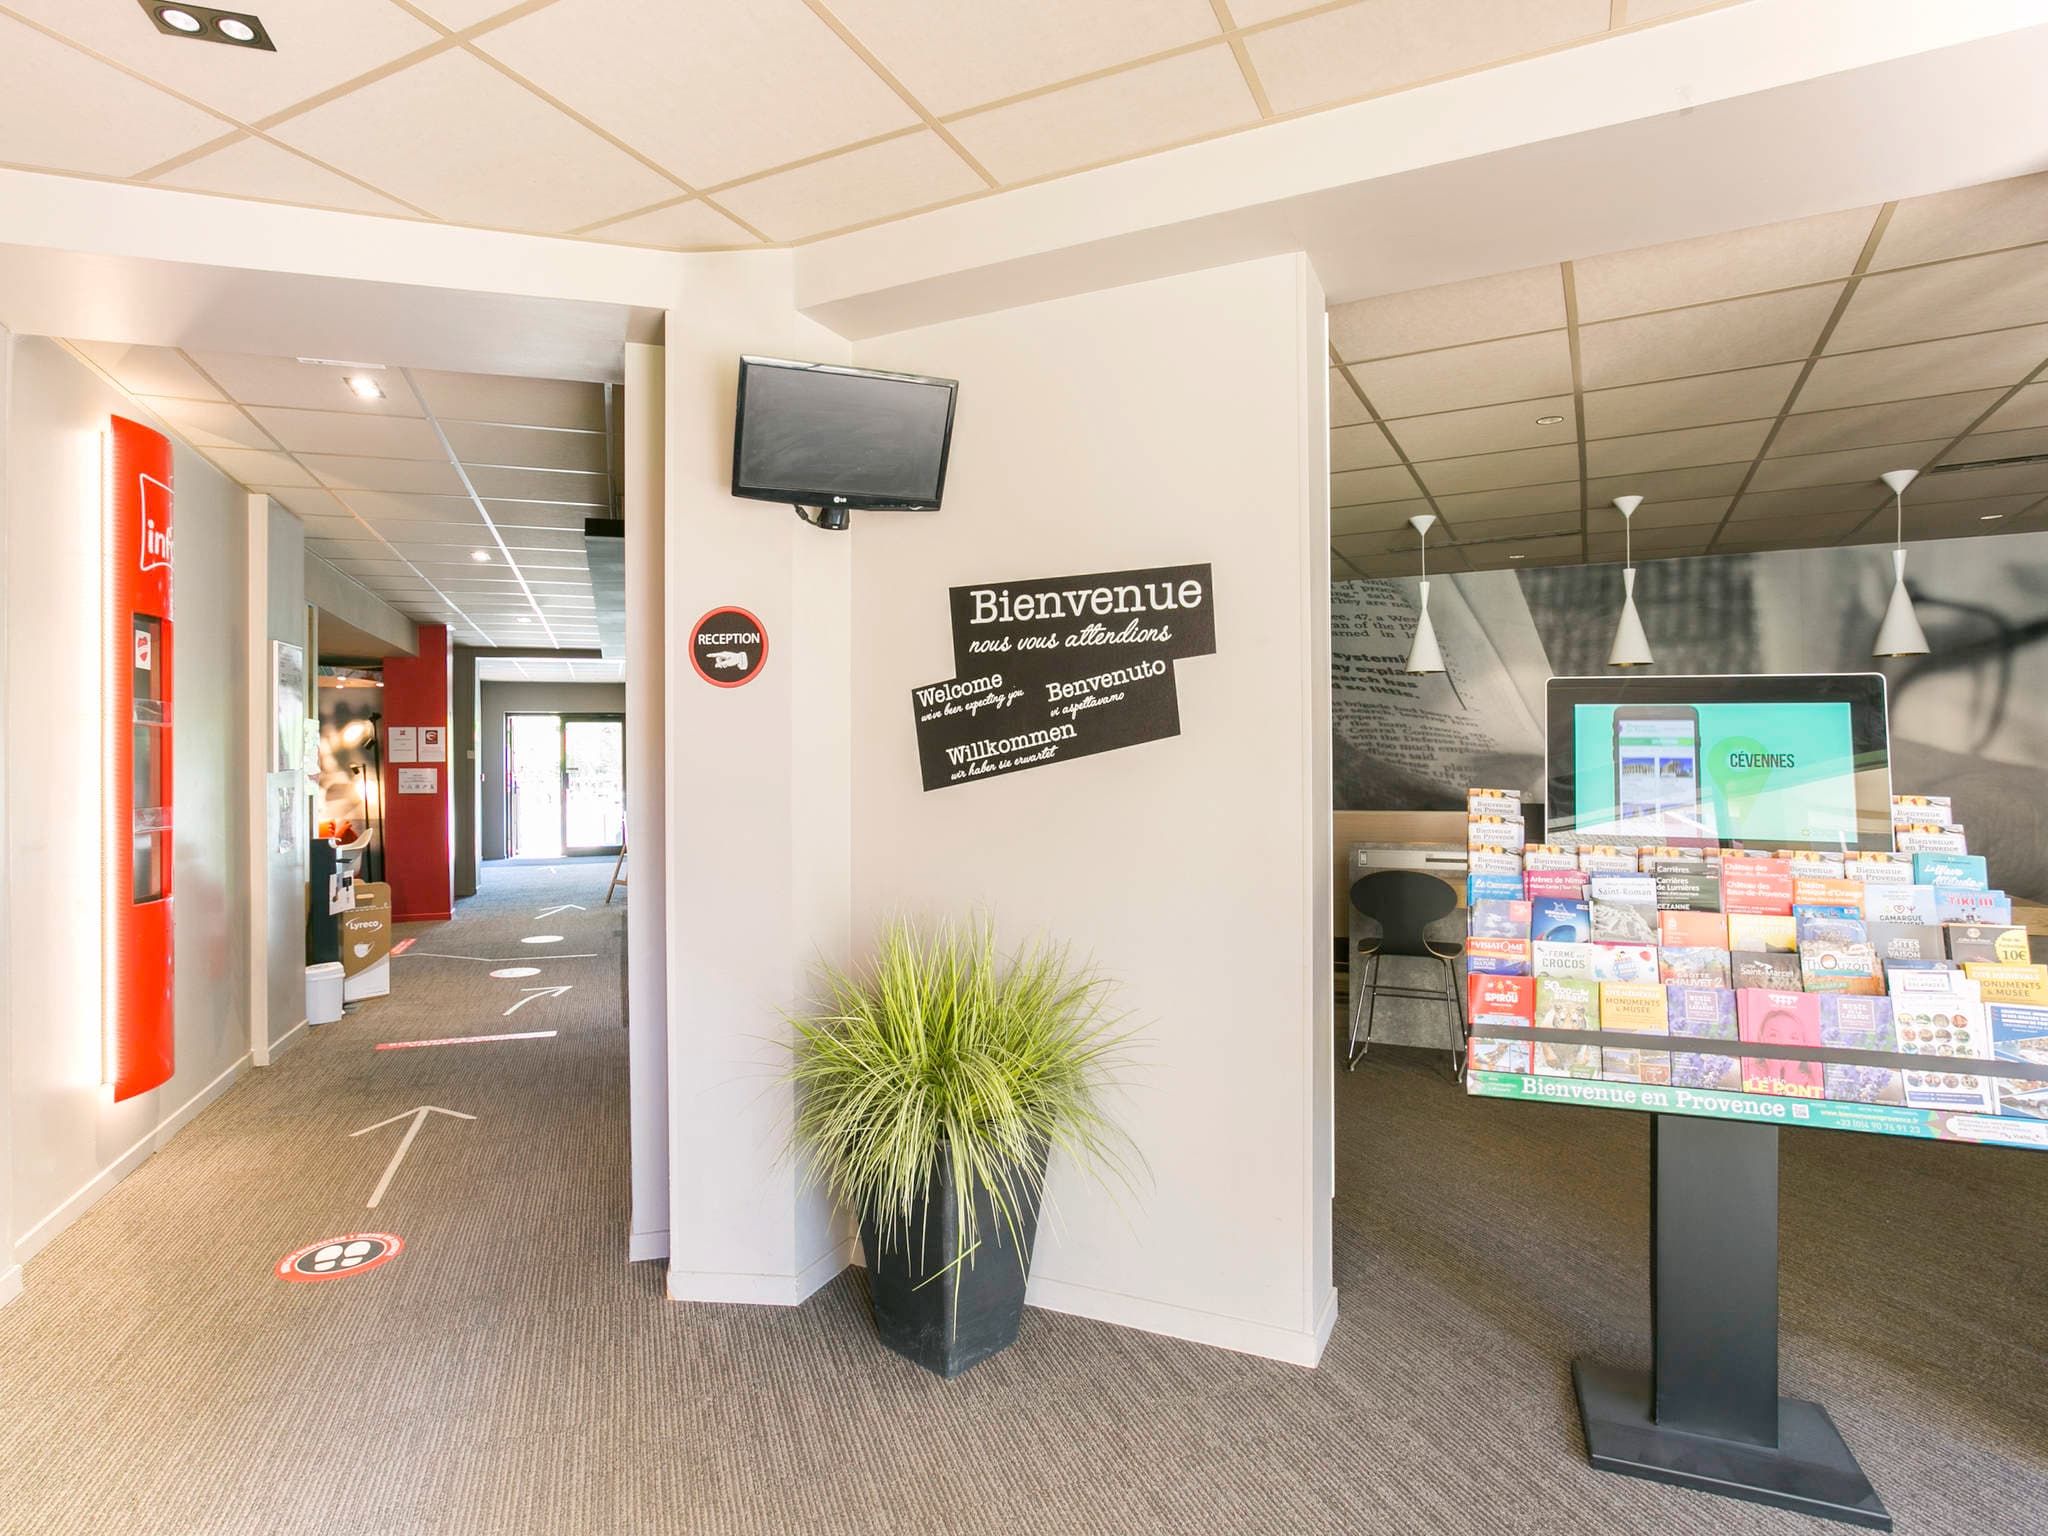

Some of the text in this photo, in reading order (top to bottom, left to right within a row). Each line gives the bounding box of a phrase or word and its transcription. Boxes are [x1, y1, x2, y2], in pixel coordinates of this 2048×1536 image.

[970, 579, 1202, 624] Bienvenue
[698, 632, 760, 645] RECEPTION
[969, 618, 1172, 653] nous vous attendions
[1046, 659, 1167, 702] Benvenuto
[916, 673, 1003, 707] Welcome
[965, 692, 1006, 717] expecting
[1006, 689, 1025, 707] you
[1062, 691, 1125, 720] aspettavamo
[946, 723, 1078, 766] Willkommen
[998, 759, 1013, 770] sie
[1014, 745, 1059, 766] erwartet
[1729, 750, 1796, 768] CÉVENNES
[1725, 864, 1767, 872] Château des
[1656, 877, 1689, 886] Carrières
[1727, 882, 1770, 890] Château des
[1598, 888, 1652, 896] Saint-Roman
[350, 920, 379, 931] Lyreco
[1542, 958, 1586, 969] CROCOS
[2002, 950, 2028, 961] 10€
[1665, 978, 1713, 987] CHAUVET
[1521, 1076, 1637, 1104] Bienvenue
[1642, 1092, 1668, 1108] en
[1676, 1091, 1786, 1118] Provence
